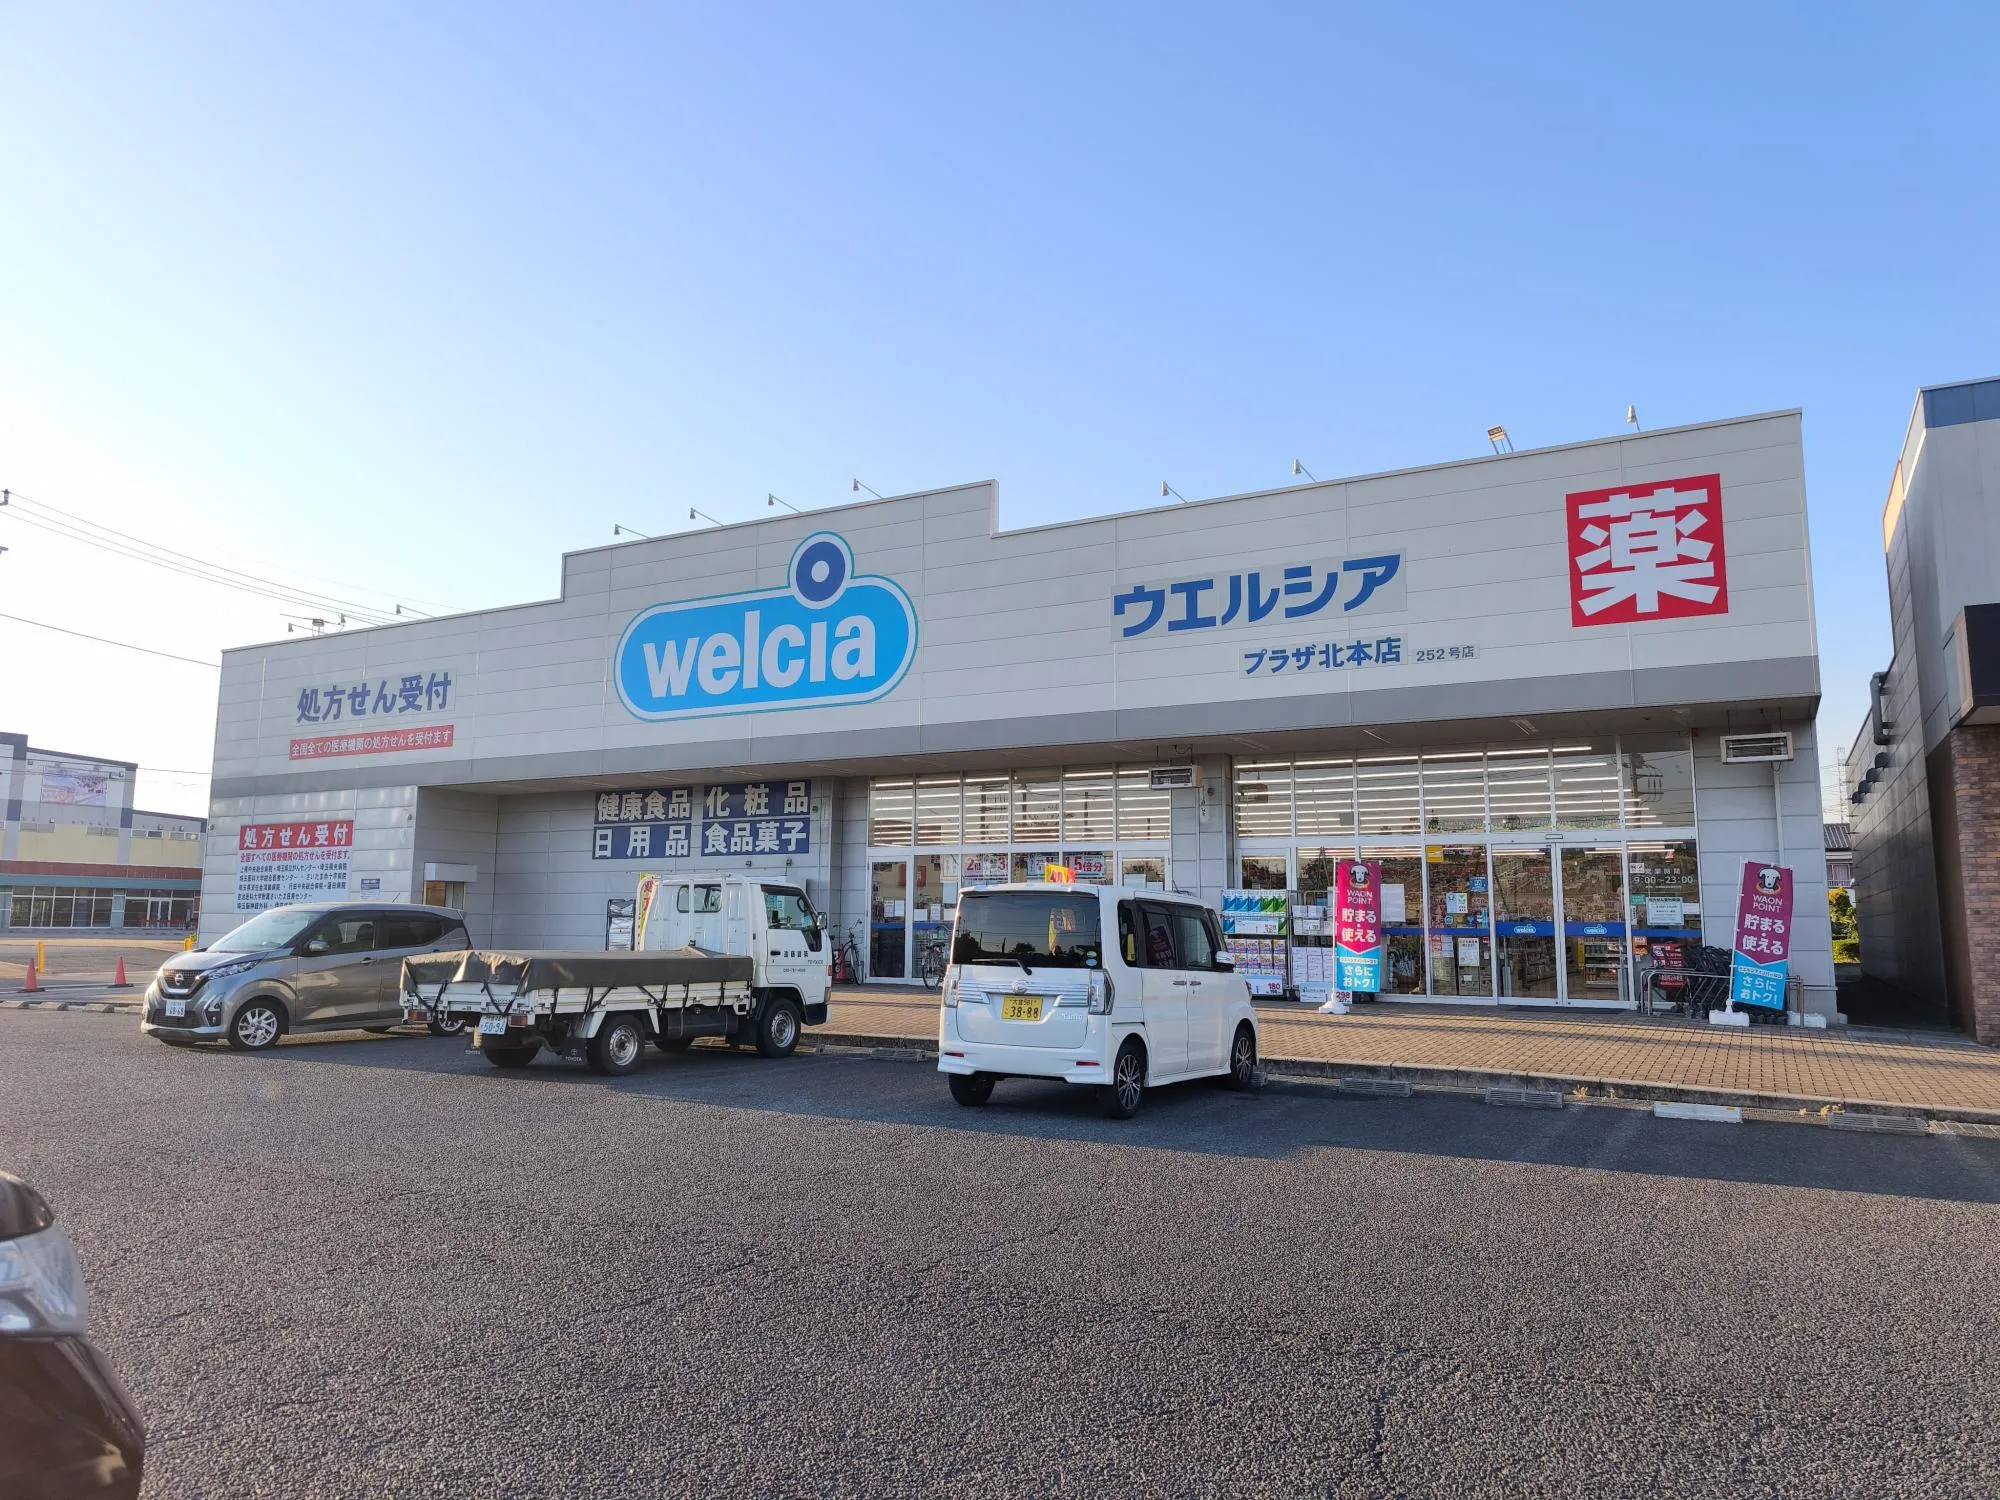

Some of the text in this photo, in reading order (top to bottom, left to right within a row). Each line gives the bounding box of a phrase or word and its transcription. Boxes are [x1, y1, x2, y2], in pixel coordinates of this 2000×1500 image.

[1575, 487, 1720, 616] 薬
[1113, 553, 1401, 638] ウエルシア
[643, 606, 876, 699] welcia
[1243, 635, 1401, 675] プラザ北本店
[297, 672, 452, 724] 処方せん受付
[597, 789, 691, 822] 健康食品
[706, 782, 808, 818] 化粧品
[243, 823, 349, 849] 処方せん受付
[594, 826, 688, 858] 日用品
[704, 821, 807, 853] 食品菓子
[1346, 889, 1373, 898] WAON
[1347, 896, 1373, 905] POINT
[1752, 893, 1783, 906] WAON
[1341, 907, 1377, 924] 貯まる
[1753, 902, 1782, 913] POINT
[1743, 914, 1785, 934] 貯まる
[1341, 927, 1377, 943] 使える
[1742, 935, 1784, 955] 使える
[1344, 965, 1374, 977] さらに
[1742, 975, 1777, 992] さらに
[1335, 990, 1351, 999] 298
